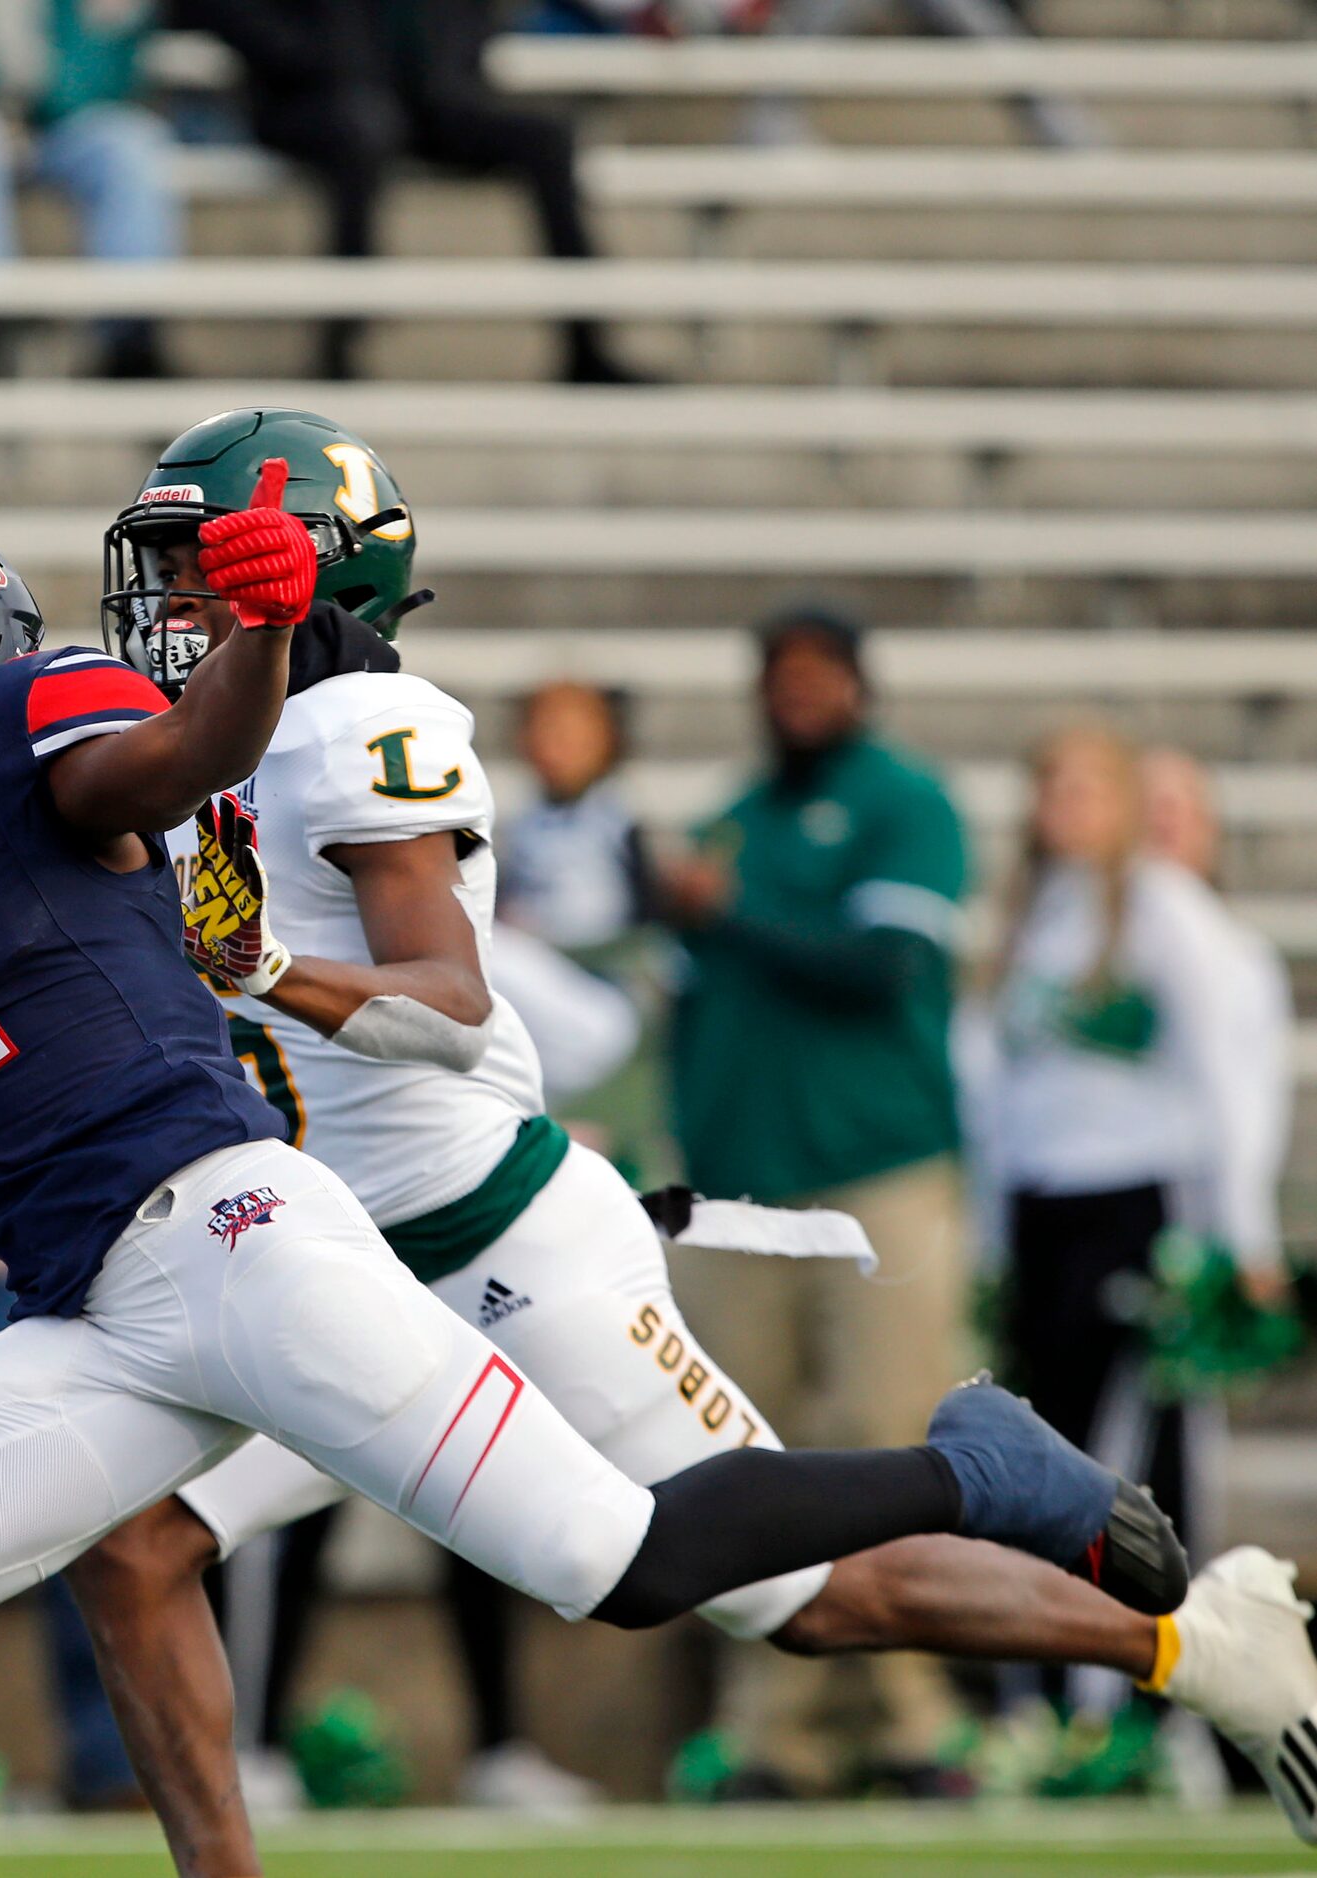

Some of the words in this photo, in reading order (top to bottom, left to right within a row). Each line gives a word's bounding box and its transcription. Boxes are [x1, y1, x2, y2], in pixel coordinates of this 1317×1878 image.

[141, 488, 191, 502] Riddell
[365, 727, 463, 802] L
[207, 1187, 280, 1236] RYAN
[478, 1296, 532, 1328] adidas
